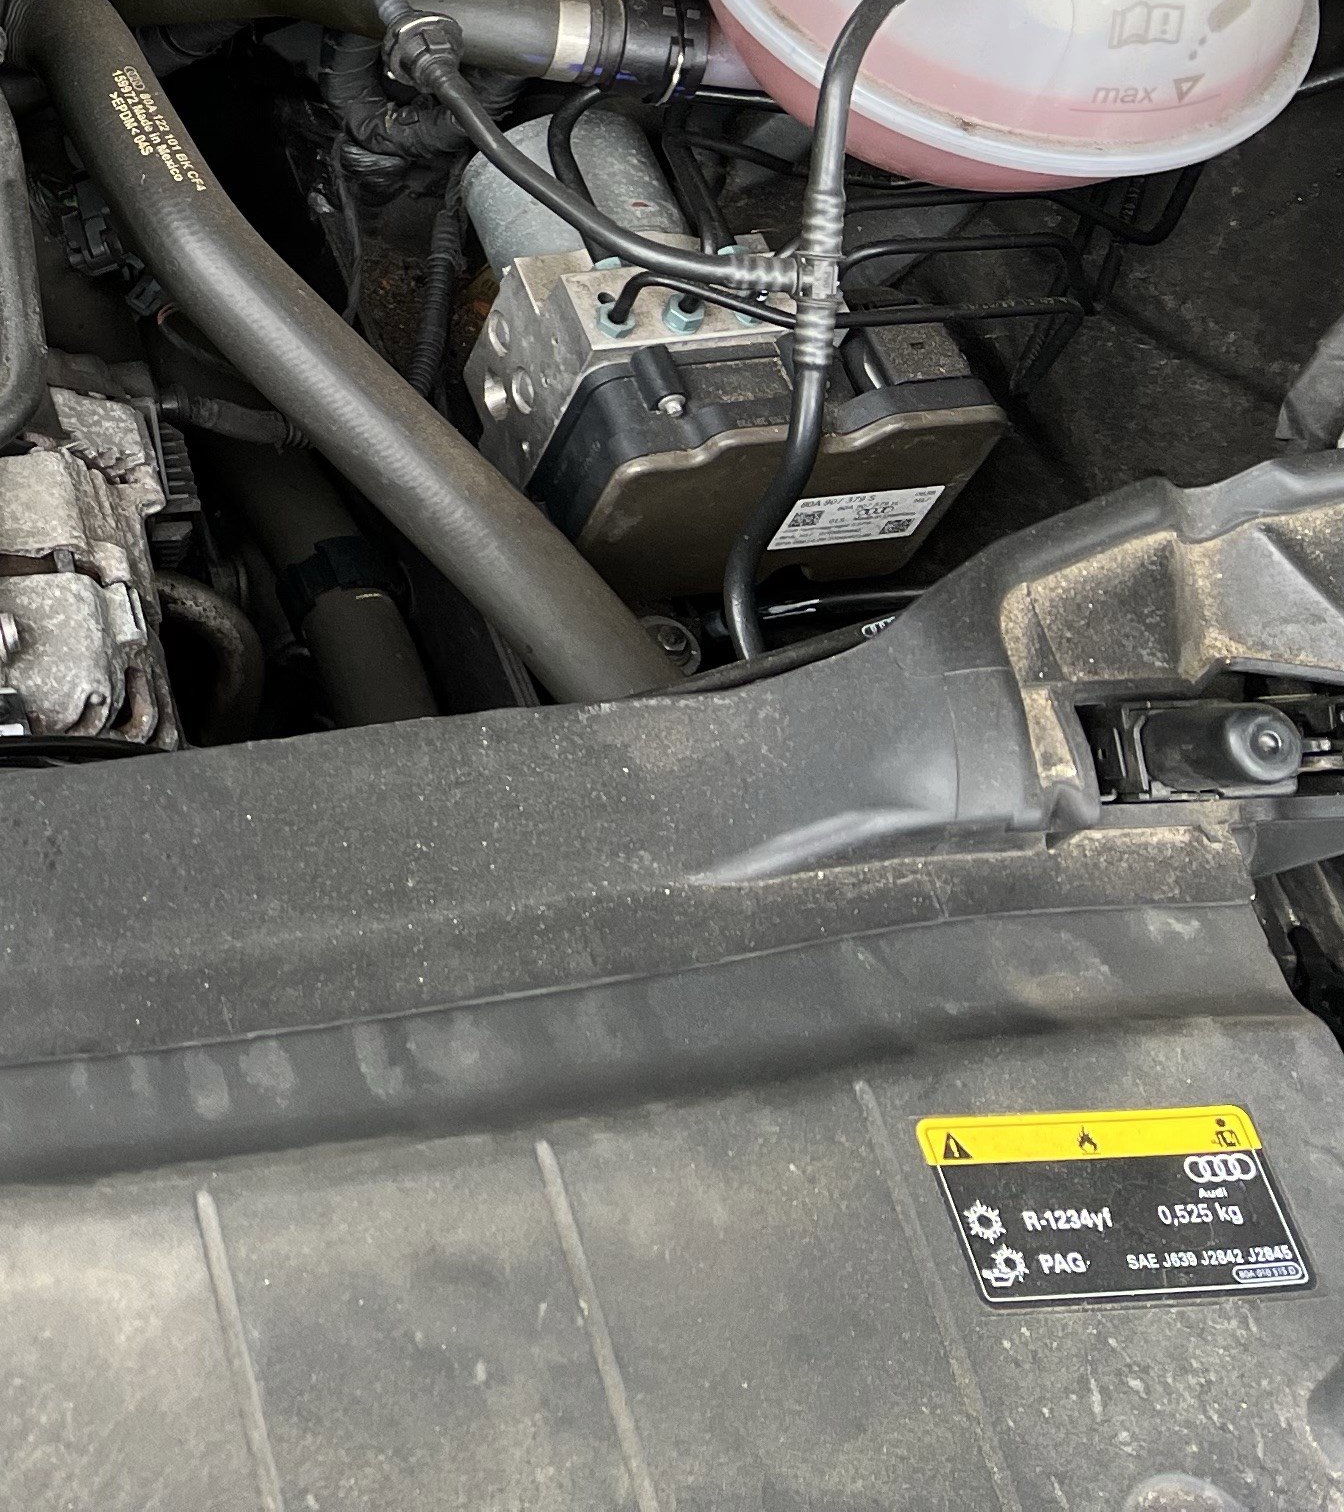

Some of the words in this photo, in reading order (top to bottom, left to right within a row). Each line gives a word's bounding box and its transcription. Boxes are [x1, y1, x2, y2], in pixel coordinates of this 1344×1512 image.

[1090, 81, 1158, 105] max
[133, 105, 153, 132] Made
[150, 133, 161, 143] in
[157, 146, 183, 181] Mexico
[154, 114, 170, 131] 122
[166, 134, 181, 150] 101
[176, 154, 192, 169] BK
[1198, 1187, 1227, 1199] Audi
[1022, 1207, 1113, 1233] R-1234yf
[1157, 1205, 1212, 1226] 0,525
[1216, 1203, 1244, 1226] kg
[1038, 1253, 1087, 1274] PAG
[1126, 1254, 1158, 1271] SAE
[1162, 1251, 1198, 1269] J639
[1200, 1249, 1245, 1267] J2842
